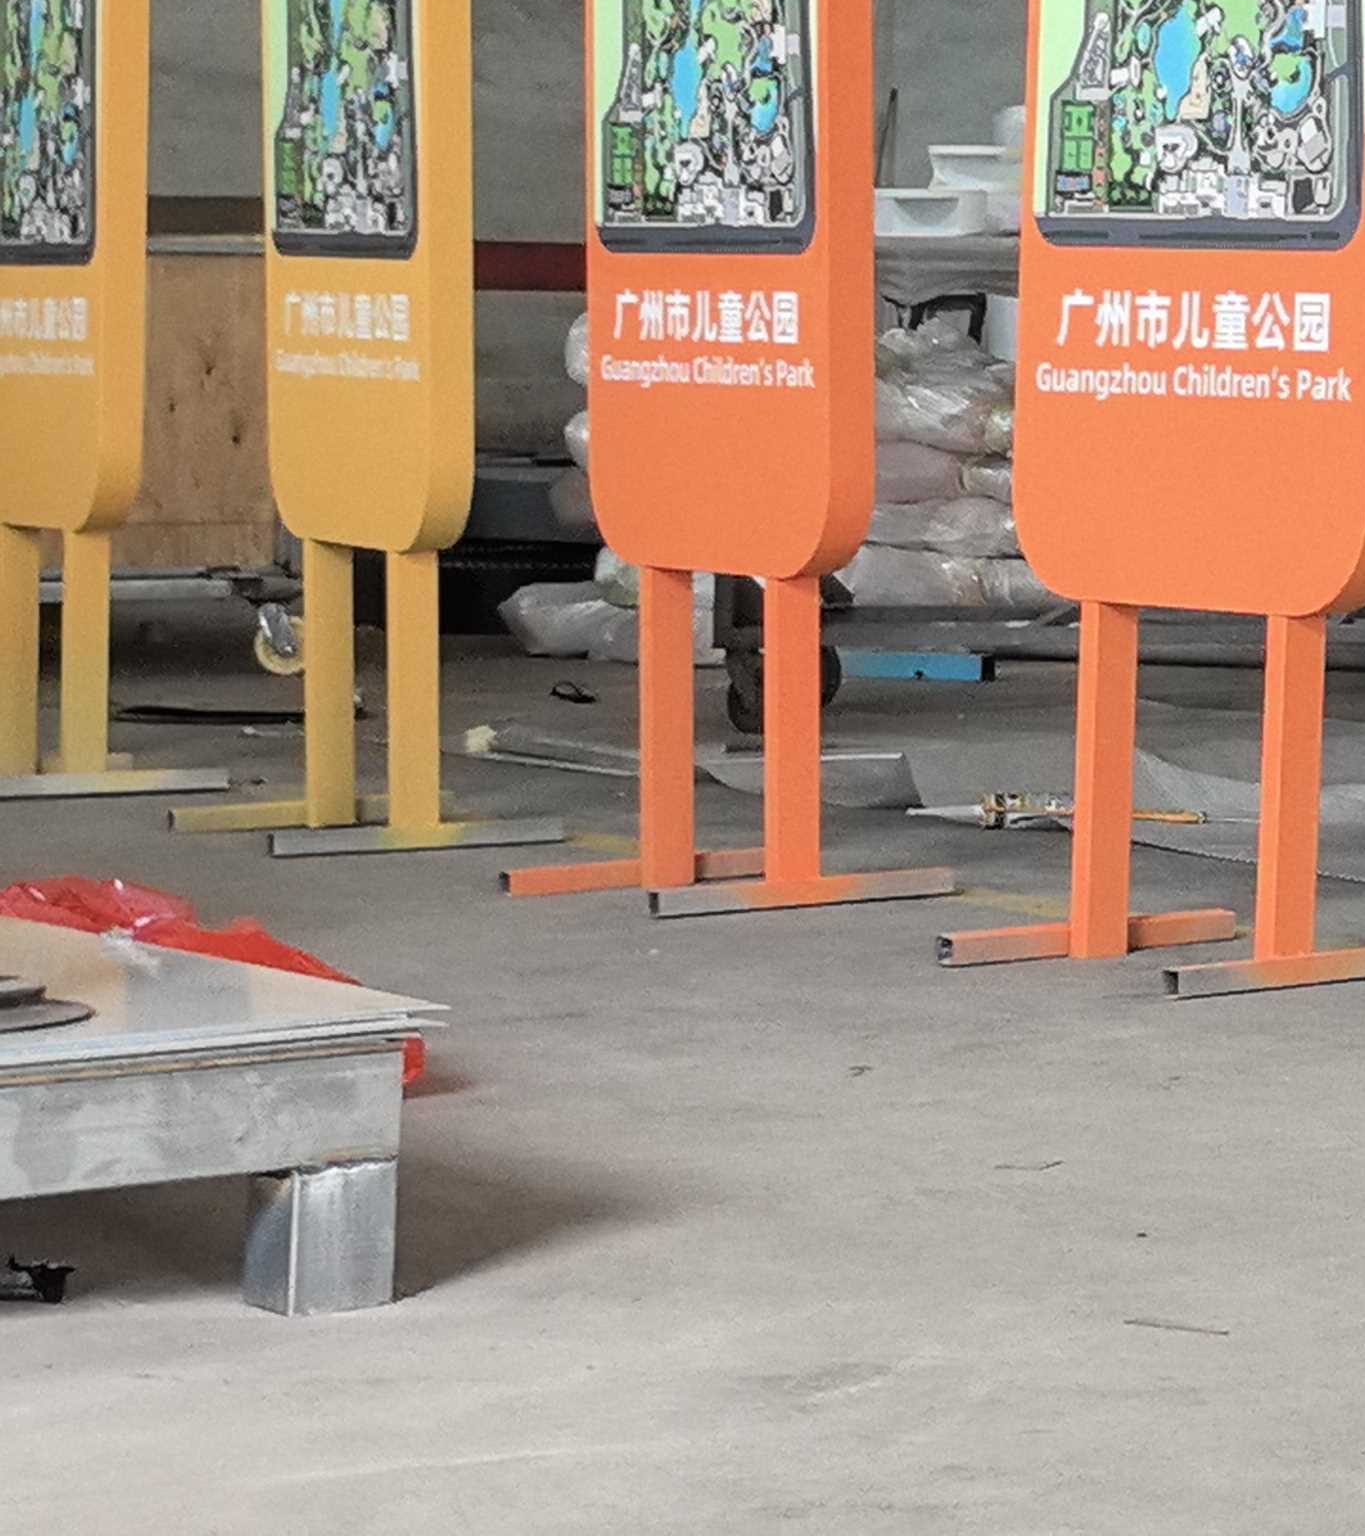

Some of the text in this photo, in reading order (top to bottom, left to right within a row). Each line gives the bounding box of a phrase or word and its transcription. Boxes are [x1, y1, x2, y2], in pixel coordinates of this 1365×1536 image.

[615, 290, 798, 344] 广州市儿童公园
[1057, 289, 1330, 352] 广州市儿童公园
[1036, 363, 1351, 400] Guangzhou Children's Park
